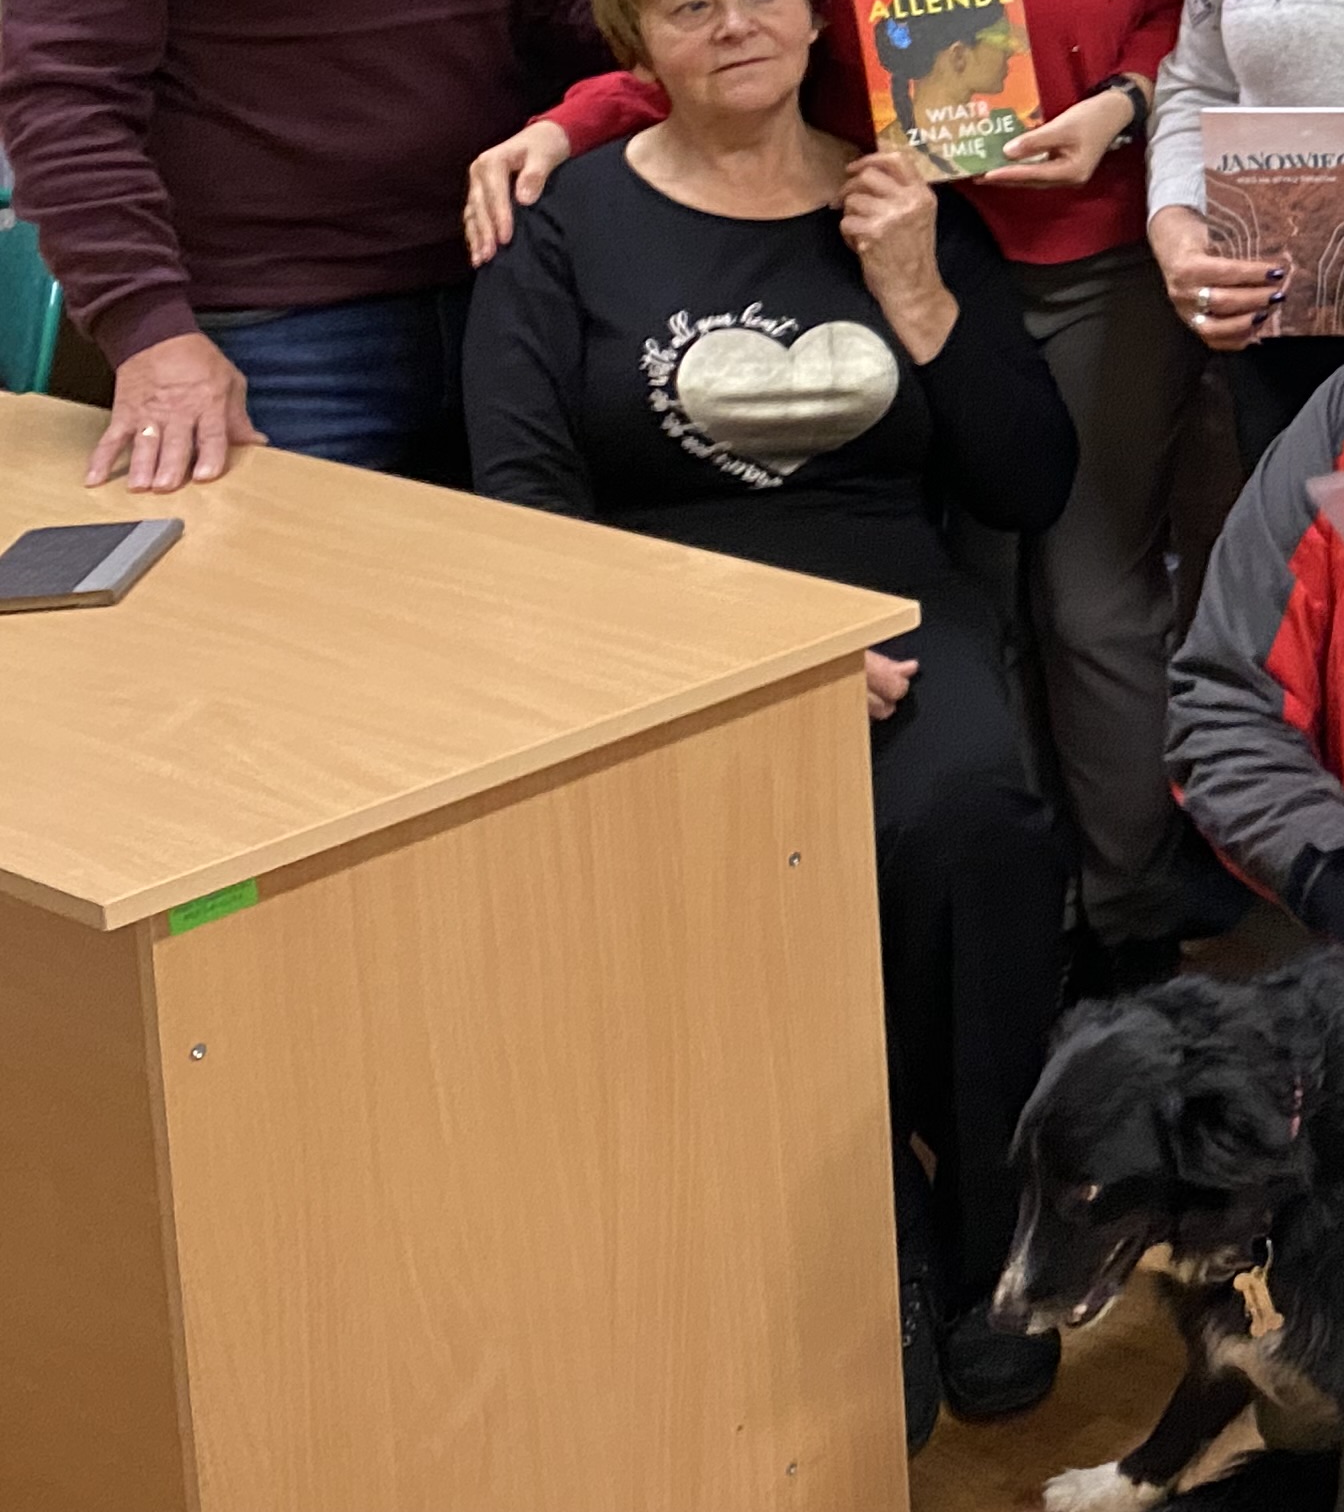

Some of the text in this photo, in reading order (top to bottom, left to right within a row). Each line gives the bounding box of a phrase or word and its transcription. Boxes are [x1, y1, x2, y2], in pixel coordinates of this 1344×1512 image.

[925, 100, 989, 123] WIATR
[906, 115, 1015, 147] ZNA MOJE
[942, 137, 987, 159] IMIĘ
